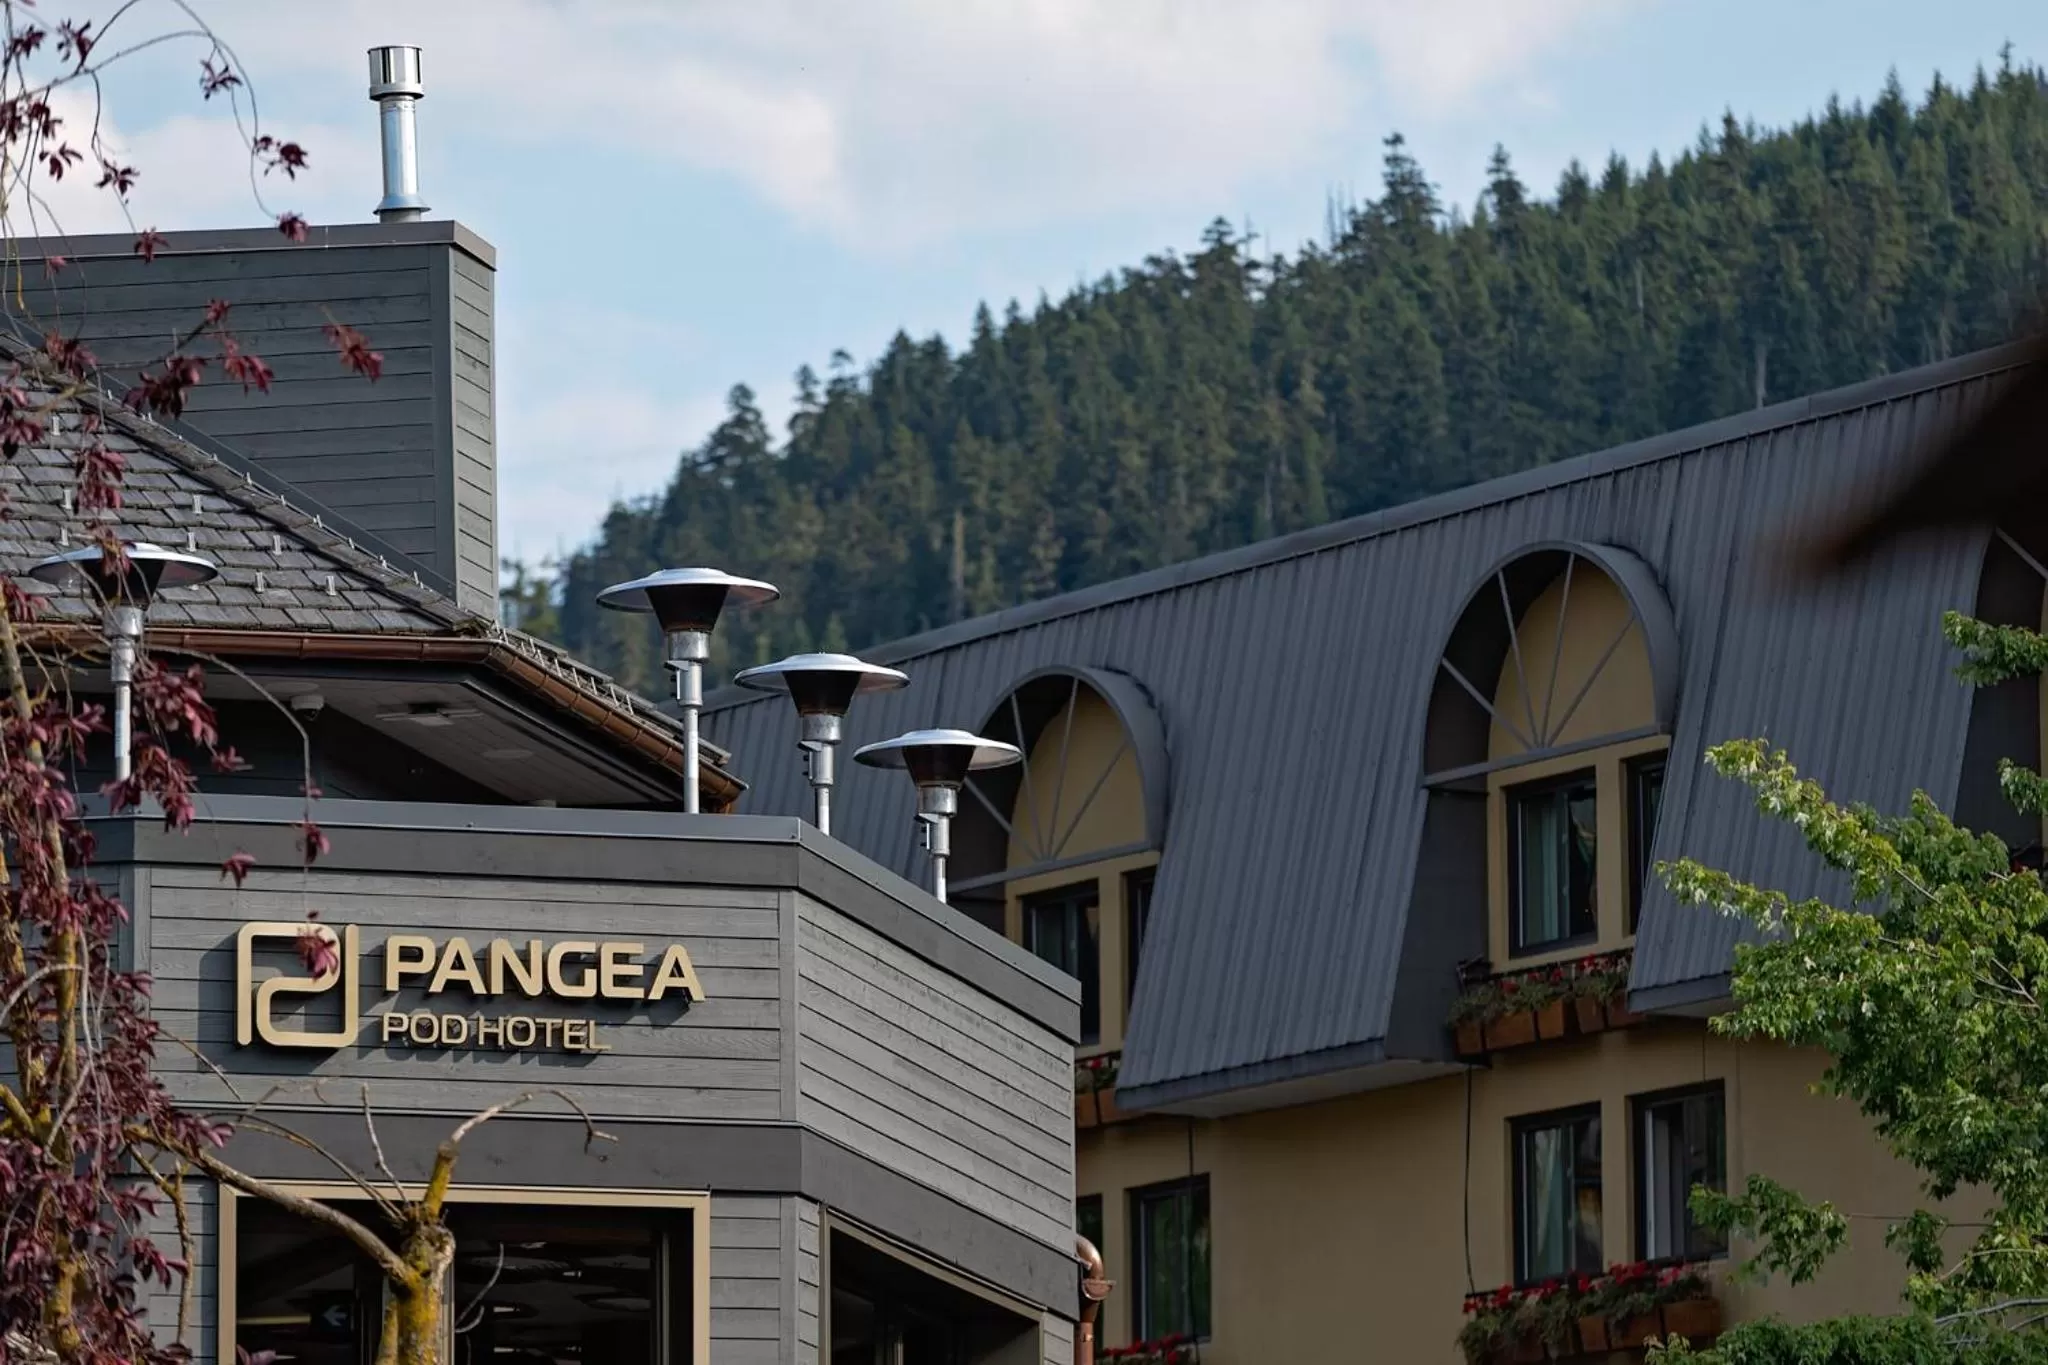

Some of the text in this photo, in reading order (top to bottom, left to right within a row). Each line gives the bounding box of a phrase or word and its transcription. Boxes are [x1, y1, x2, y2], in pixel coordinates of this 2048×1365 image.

[385, 935, 705, 1000] PANGEA
[382, 1012, 611, 1052] POD HOTEL
